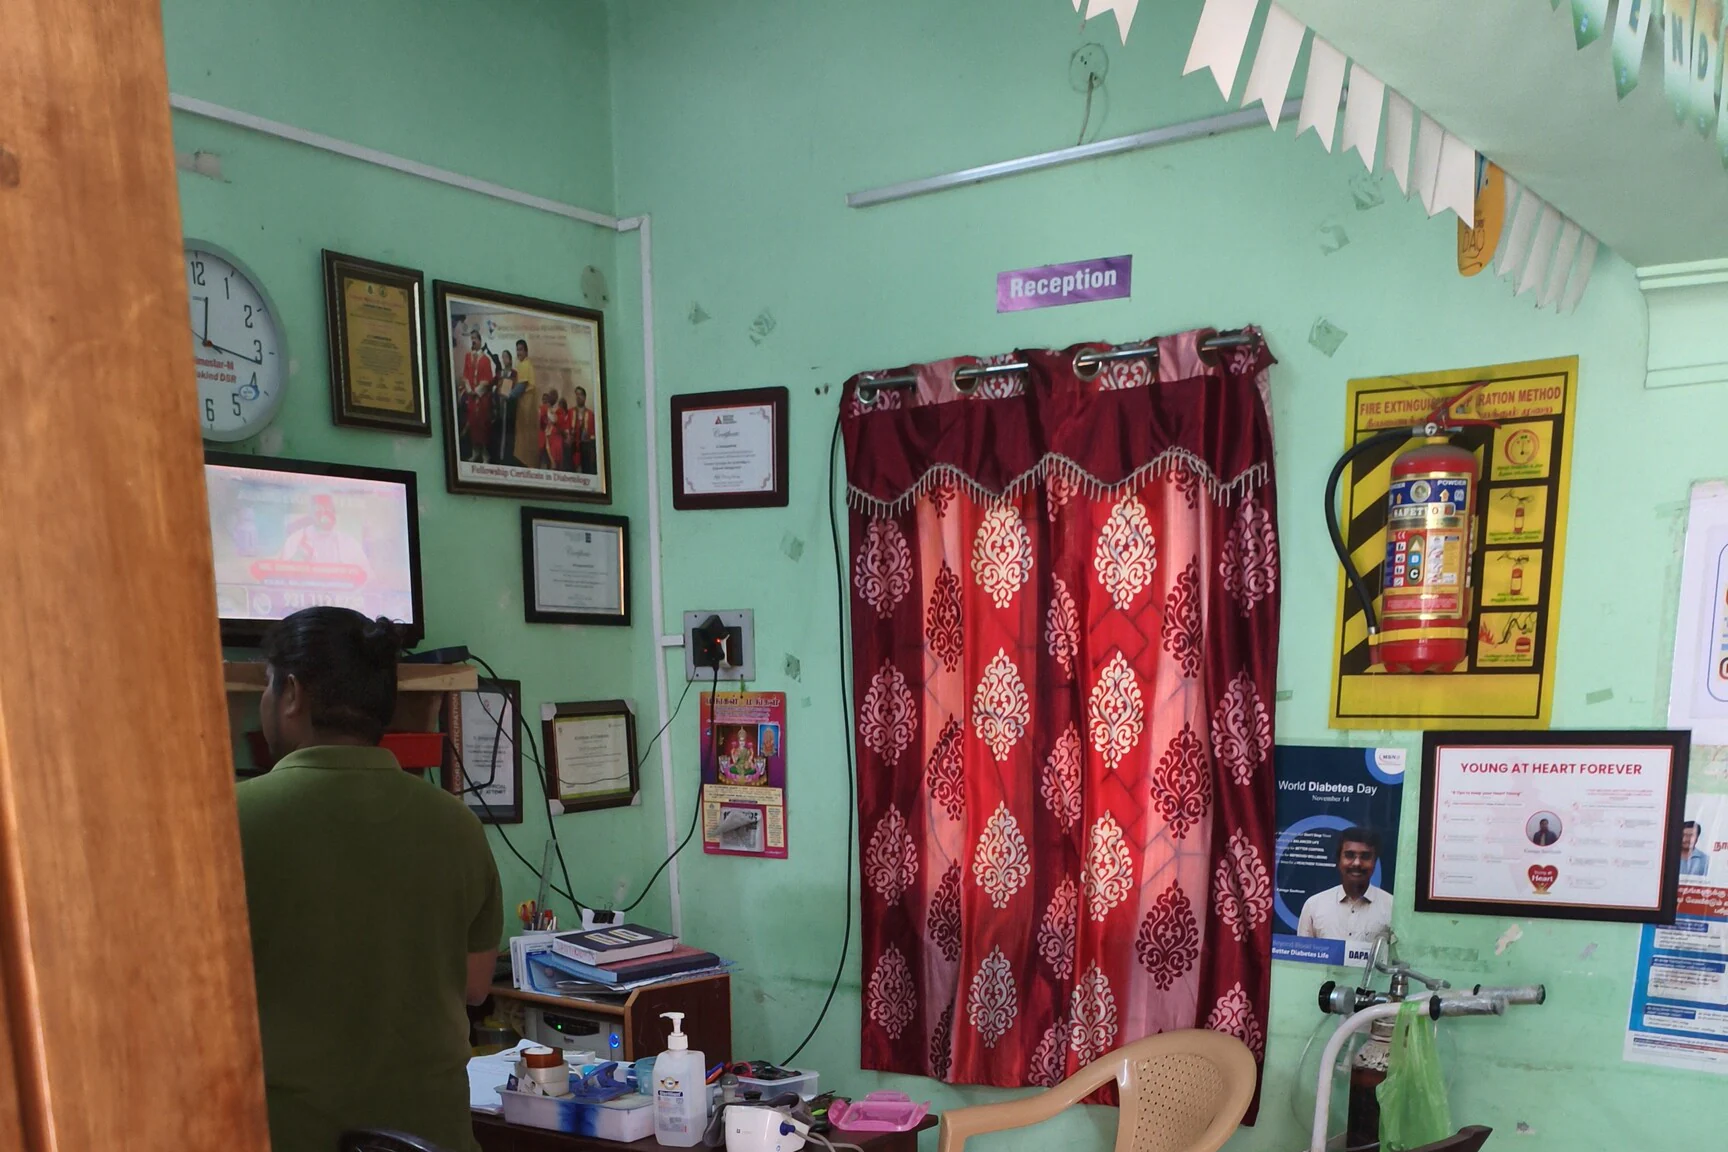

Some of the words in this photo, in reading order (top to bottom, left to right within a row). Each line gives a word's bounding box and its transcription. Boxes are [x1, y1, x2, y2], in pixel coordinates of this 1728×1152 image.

[191, 261, 205, 286] 12
[1010, 268, 1117, 298] Reception
[224, 276, 230, 300] 1
[244, 304, 253, 328] 2
[253, 339, 263, 363] 3
[205, 398, 215, 422] 6
[232, 392, 241, 416] 5
[1361, 401, 1381, 415] FIRE
[1519, 386, 1561, 402] METHOD
[471, 465, 509, 478] Fellowship
[510, 469, 544, 480] Certificate
[545, 472, 552, 481] in
[553, 472, 591, 486] Diabetology
[1460, 763, 1508, 773] YOUNG
[1511, 763, 1529, 773] AT
[1532, 763, 1577, 774] HEART
[1580, 763, 1642, 774] FOREVER
[1278, 780, 1306, 791] World
[1309, 781, 1354, 793] Diabetes
[1357, 783, 1378, 796] Day
[1312, 795, 1341, 803] November
[1531, 874, 1553, 883] Heart
[1290, 948, 1317, 958] Diabetes
[1317, 951, 1330, 959] Life
